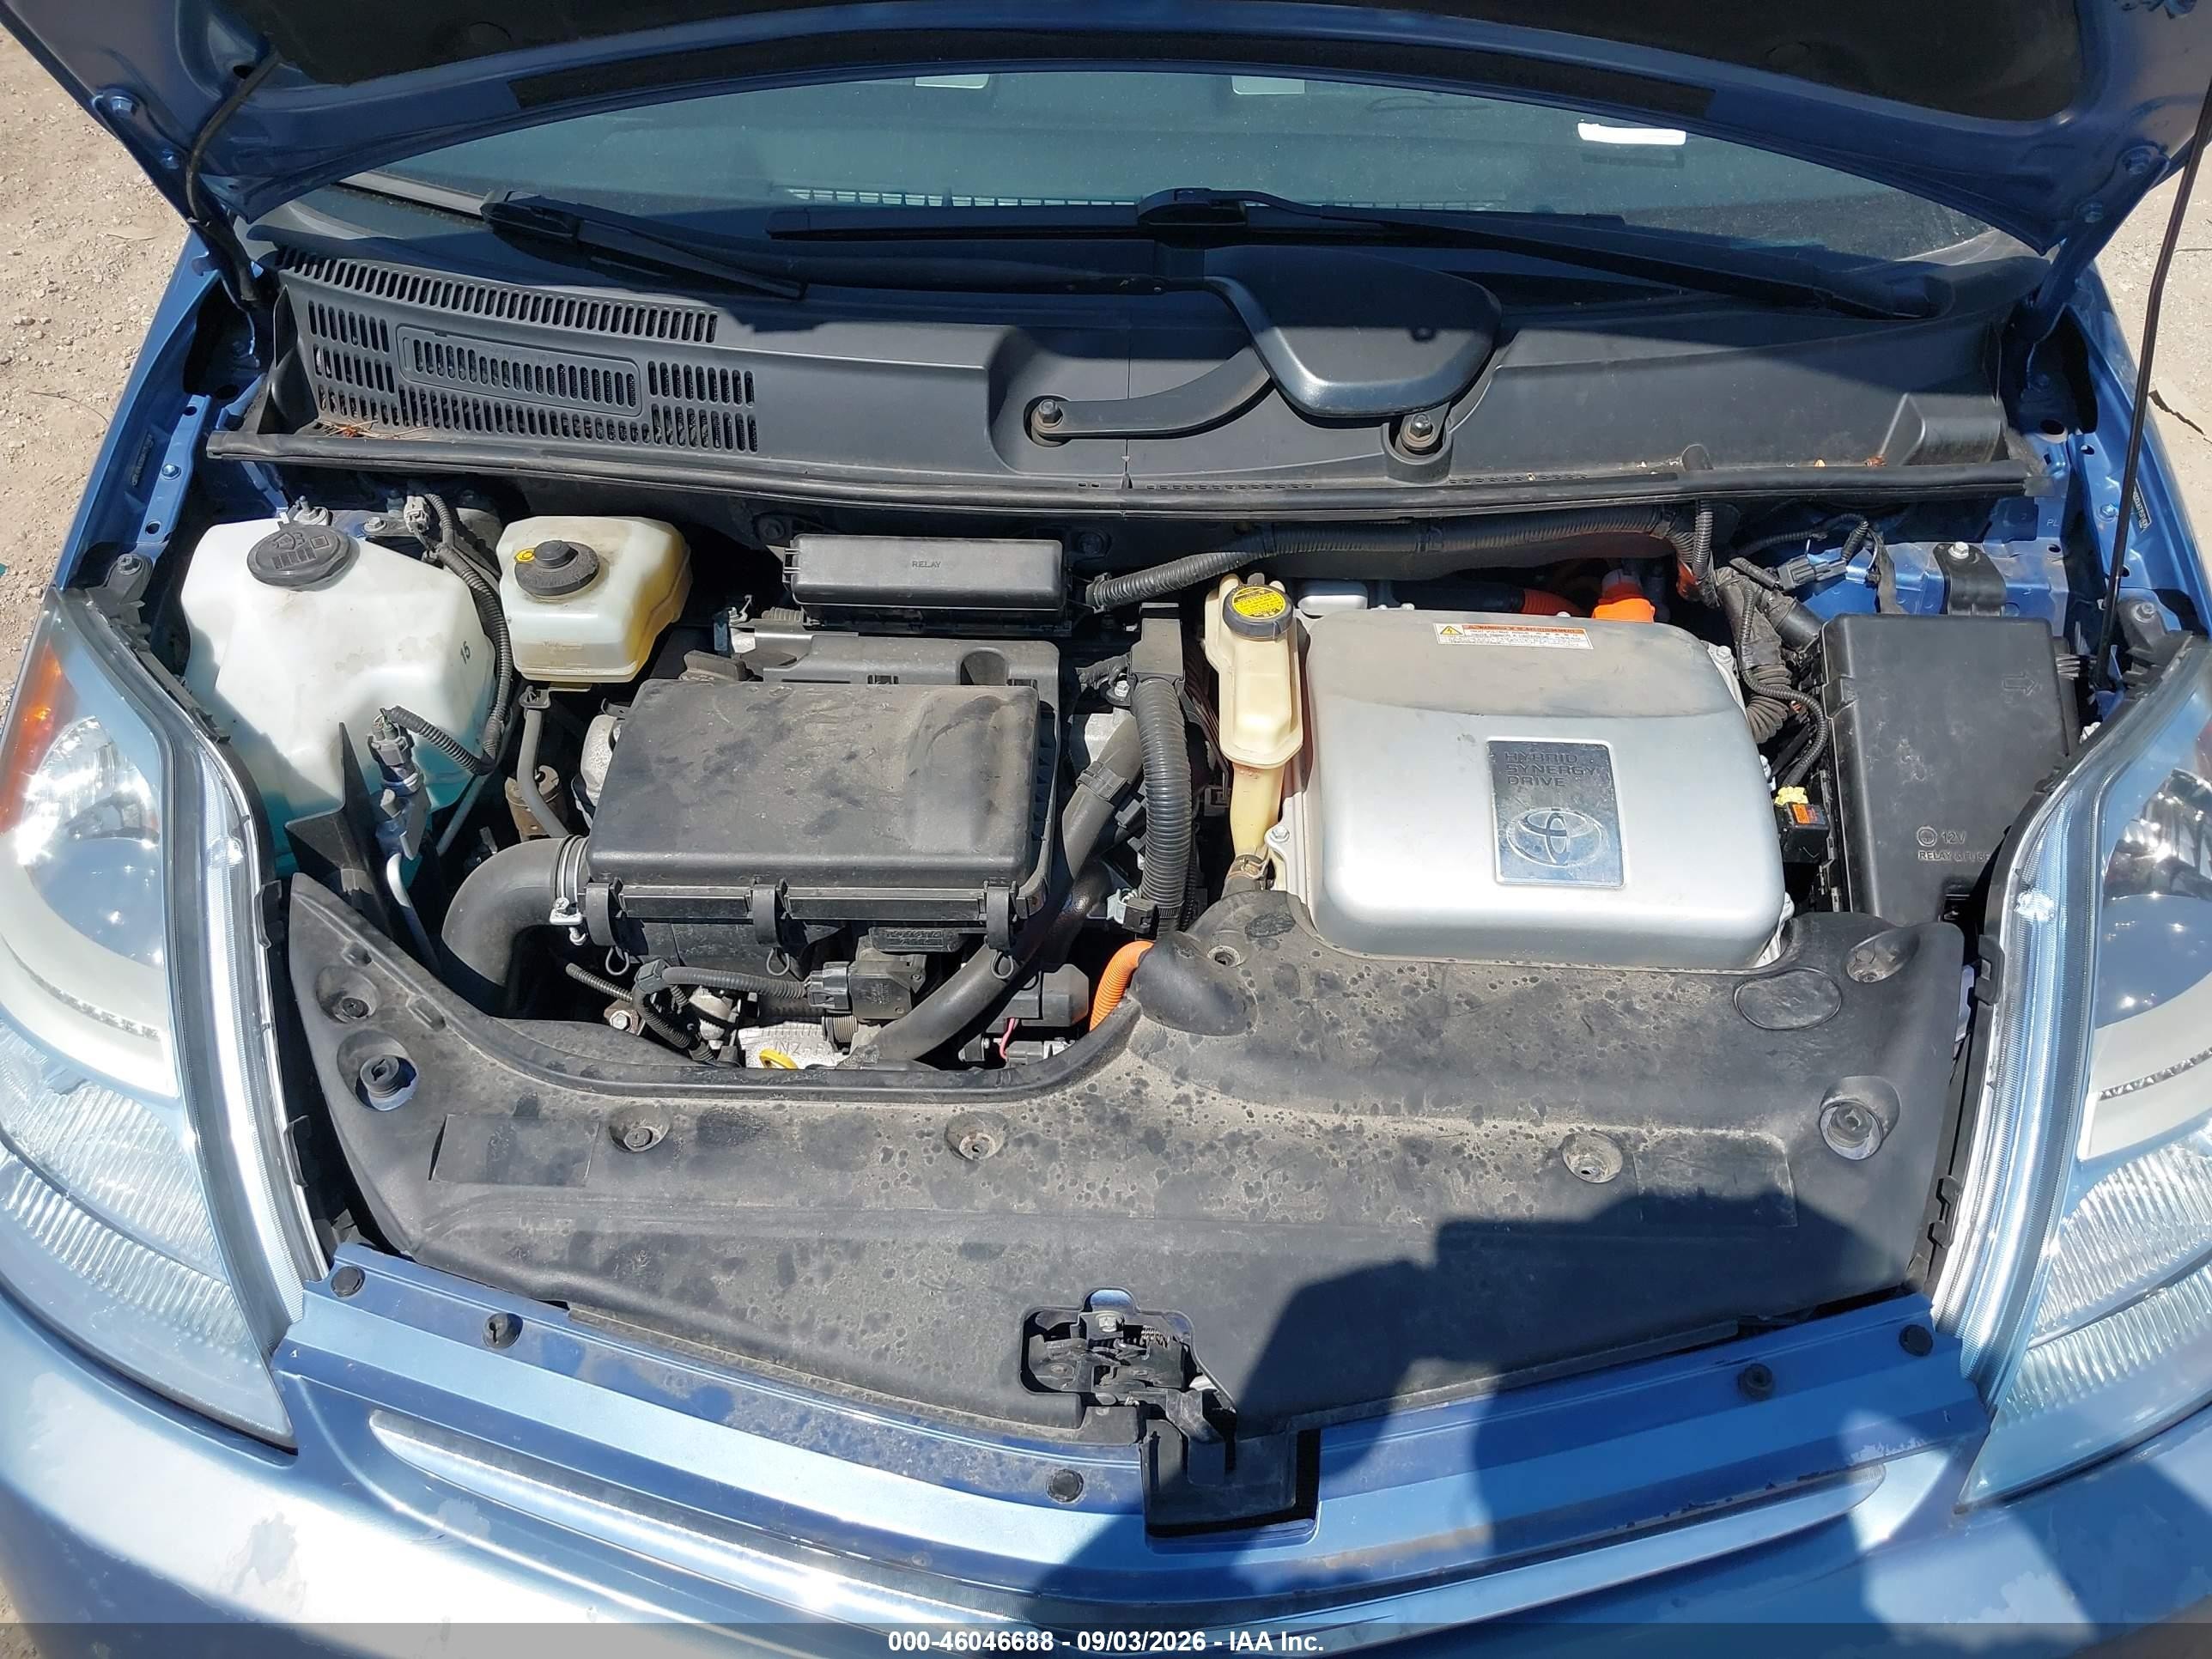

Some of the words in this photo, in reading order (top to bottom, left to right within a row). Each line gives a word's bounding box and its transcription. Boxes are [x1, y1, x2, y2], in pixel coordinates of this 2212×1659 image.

[911, 560, 941, 568] RELAY
[1504, 751, 1579, 764] HYBRID
[1505, 763, 1598, 776] SYNERGY
[1507, 775, 1567, 787] DRIVE
[1942, 831, 1966, 844] 12V
[1918, 850, 1952, 861] RELAY
